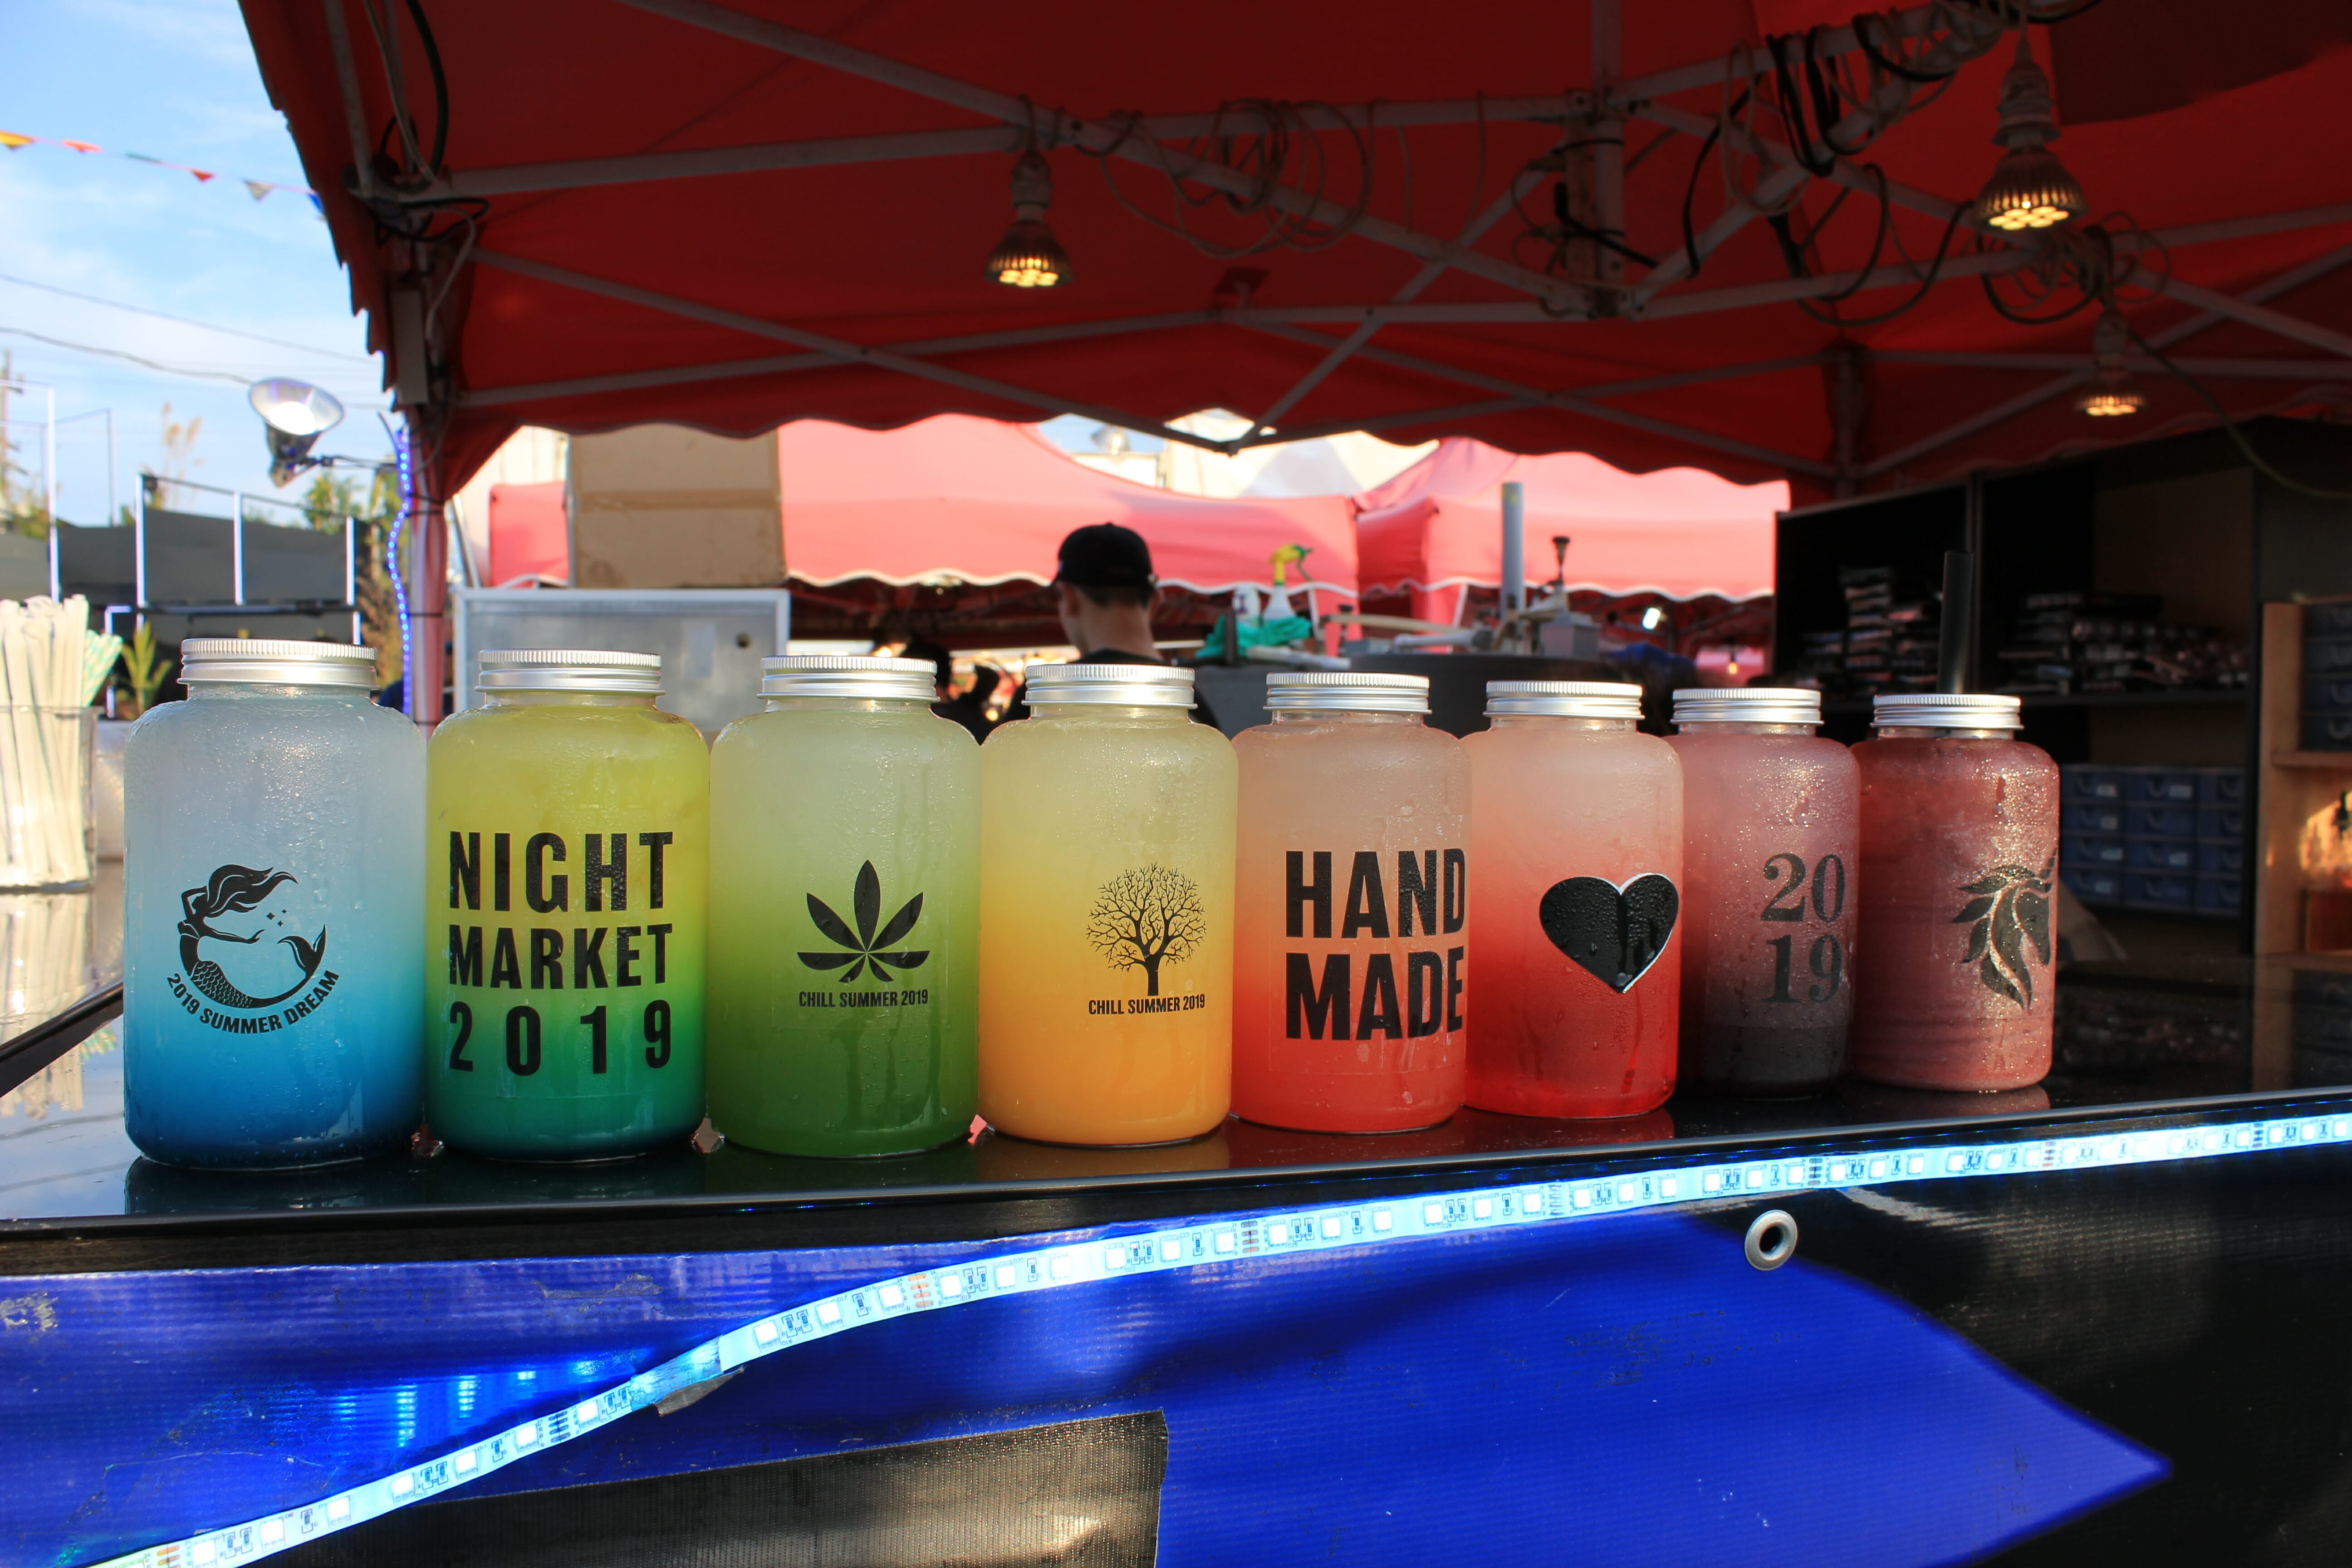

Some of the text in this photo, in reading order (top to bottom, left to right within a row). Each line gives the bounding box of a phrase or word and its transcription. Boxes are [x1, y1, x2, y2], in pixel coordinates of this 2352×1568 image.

[450, 831, 673, 913] NIGHT
[1286, 848, 1465, 938] HAND
[1761, 853, 1845, 922] 20
[449, 923, 672, 990] MARKET
[1761, 935, 1842, 1003] 19
[167, 970, 340, 1034] 2019 SUMMER DREAM
[799, 989, 928, 1007] CHILL SUMMER 2019
[1089, 994, 1205, 1014] CHILL SUMMER 2019
[1286, 946, 1464, 1040] MADE
[449, 999, 671, 1076] 2019
